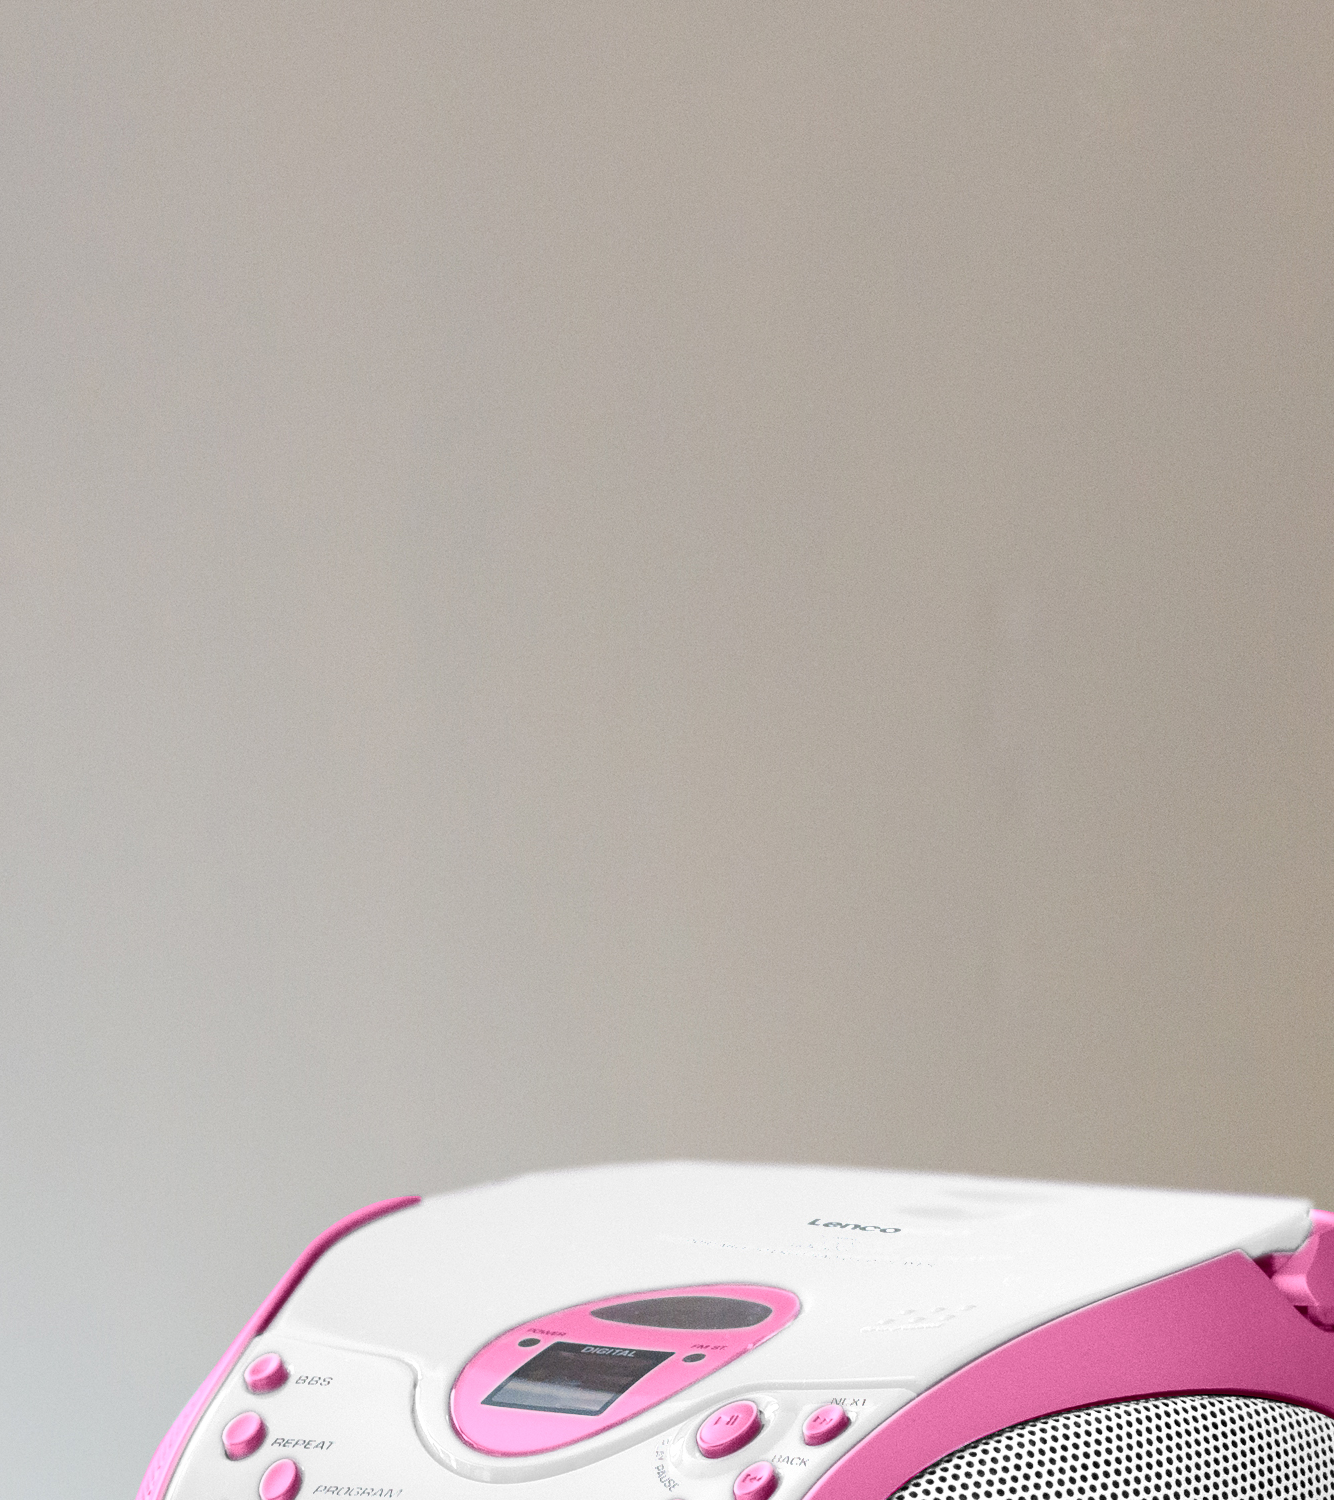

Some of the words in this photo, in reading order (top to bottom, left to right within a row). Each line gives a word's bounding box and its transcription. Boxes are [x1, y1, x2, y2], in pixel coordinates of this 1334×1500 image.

[807, 1218, 902, 1234] Lenco
[527, 1327, 567, 1337] POWER
[580, 1345, 637, 1358] DIGITAL
[295, 1374, 334, 1387] BBS
[270, 1437, 335, 1451] REPEAT
[771, 1454, 810, 1468] BACK
[654, 1464, 680, 1492] PAUSE
[312, 1484, 404, 1499] PROGRAM
